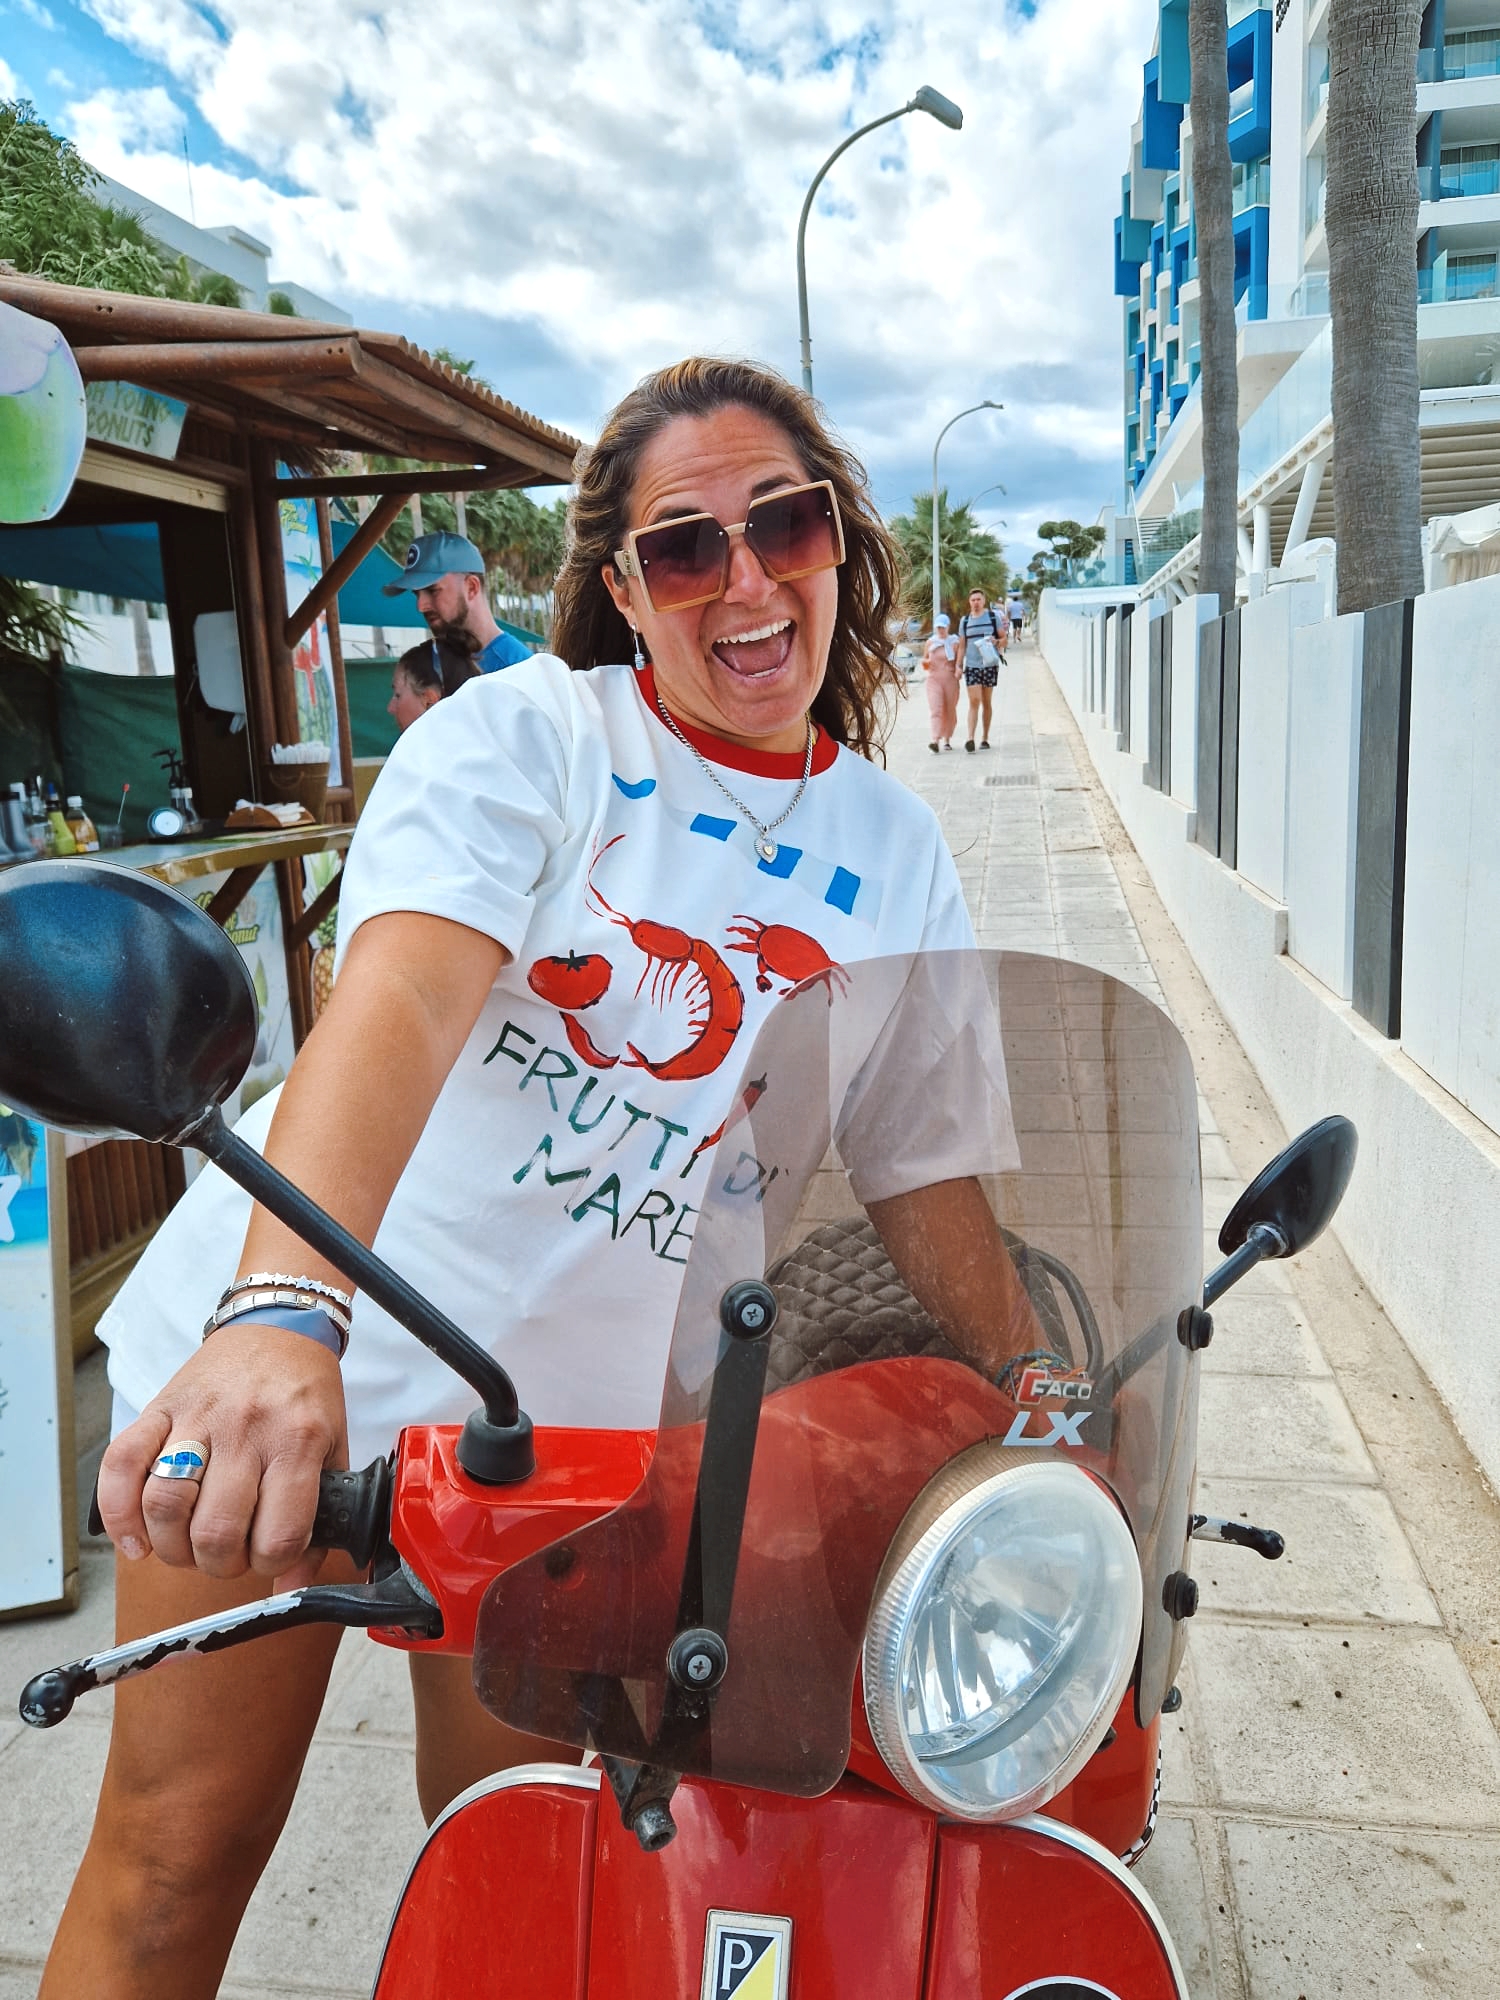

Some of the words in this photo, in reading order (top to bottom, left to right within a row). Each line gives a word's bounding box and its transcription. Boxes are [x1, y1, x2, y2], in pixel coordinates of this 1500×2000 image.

[482, 1020, 709, 1179] FRUTTI
[512, 1133, 713, 1265] MARE
[1001, 1410, 1093, 1447] LX
[720, 1938, 753, 1990] P
